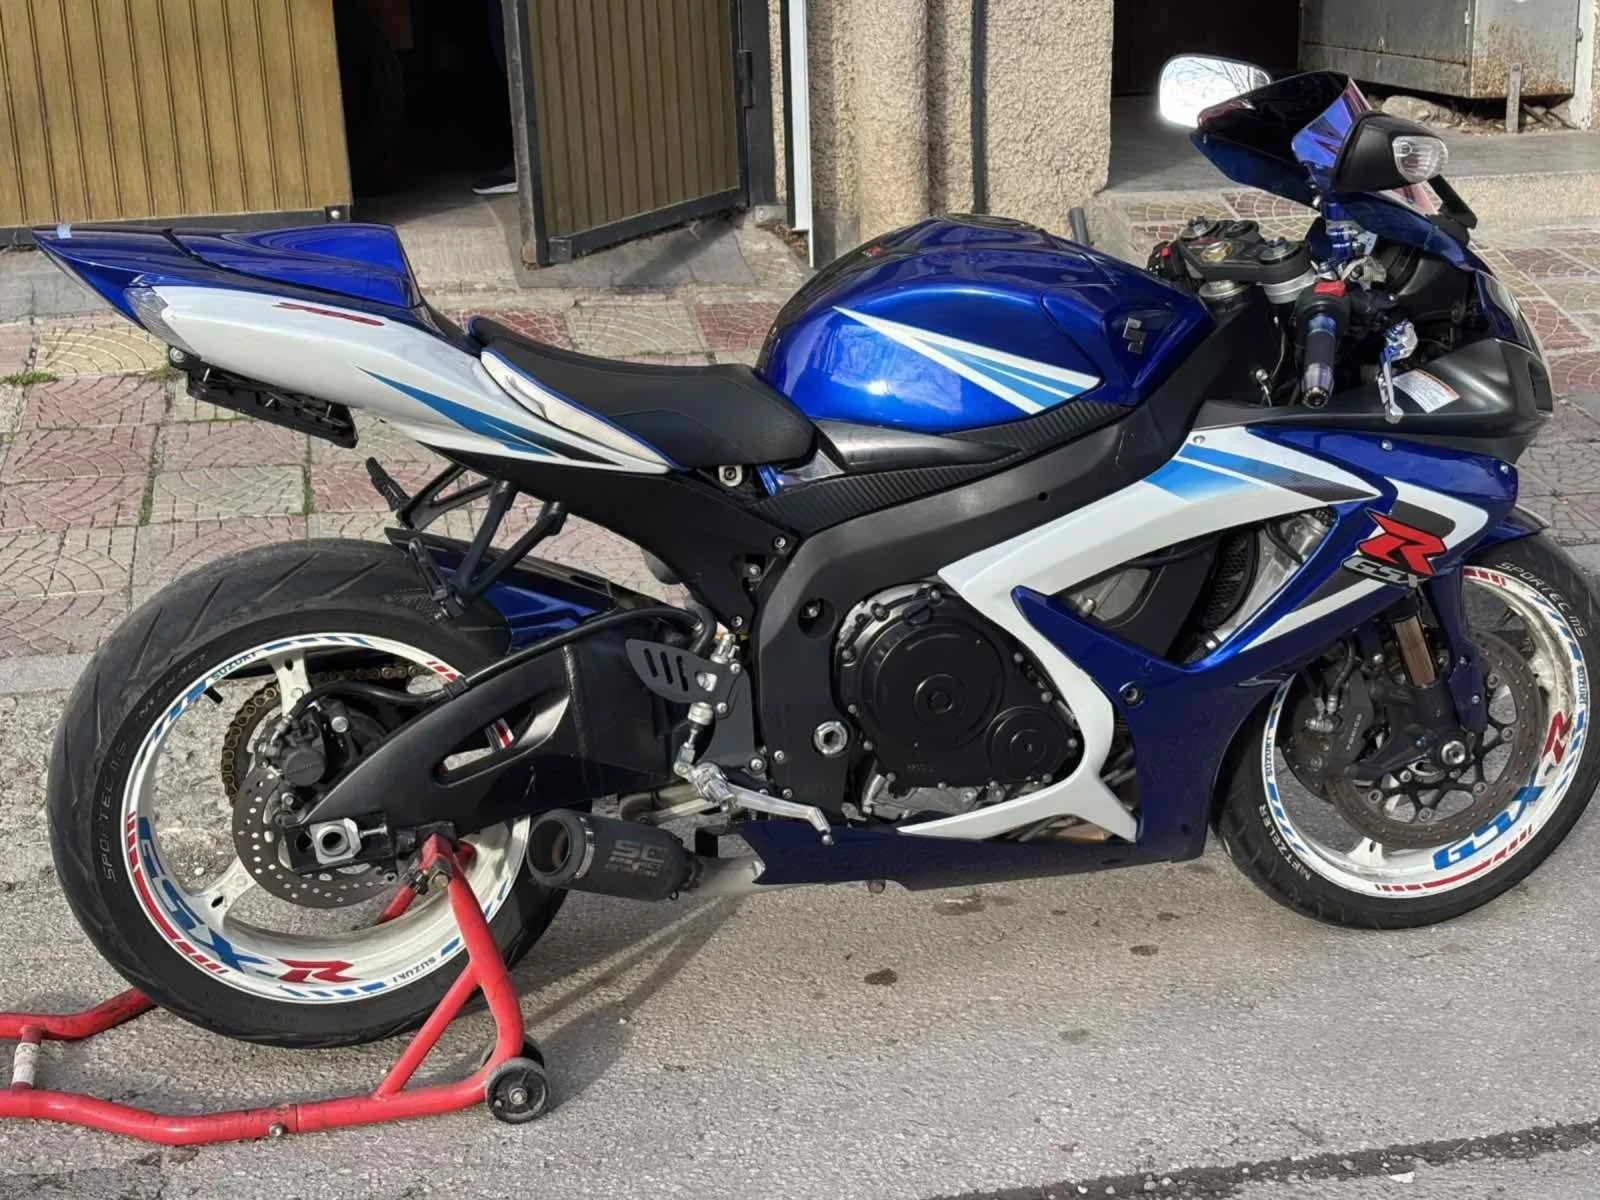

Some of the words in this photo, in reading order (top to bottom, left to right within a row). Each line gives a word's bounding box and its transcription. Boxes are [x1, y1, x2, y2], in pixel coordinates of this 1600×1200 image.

[1495, 562, 1572, 612] SPORTEC
[212, 652, 257, 681] SUZUKI
[1576, 666, 1587, 705] SUZUKI
[1264, 737, 1274, 778] SUZUKI
[1259, 803, 1312, 881] METZELER
[392, 956, 436, 983] SUZUKI
